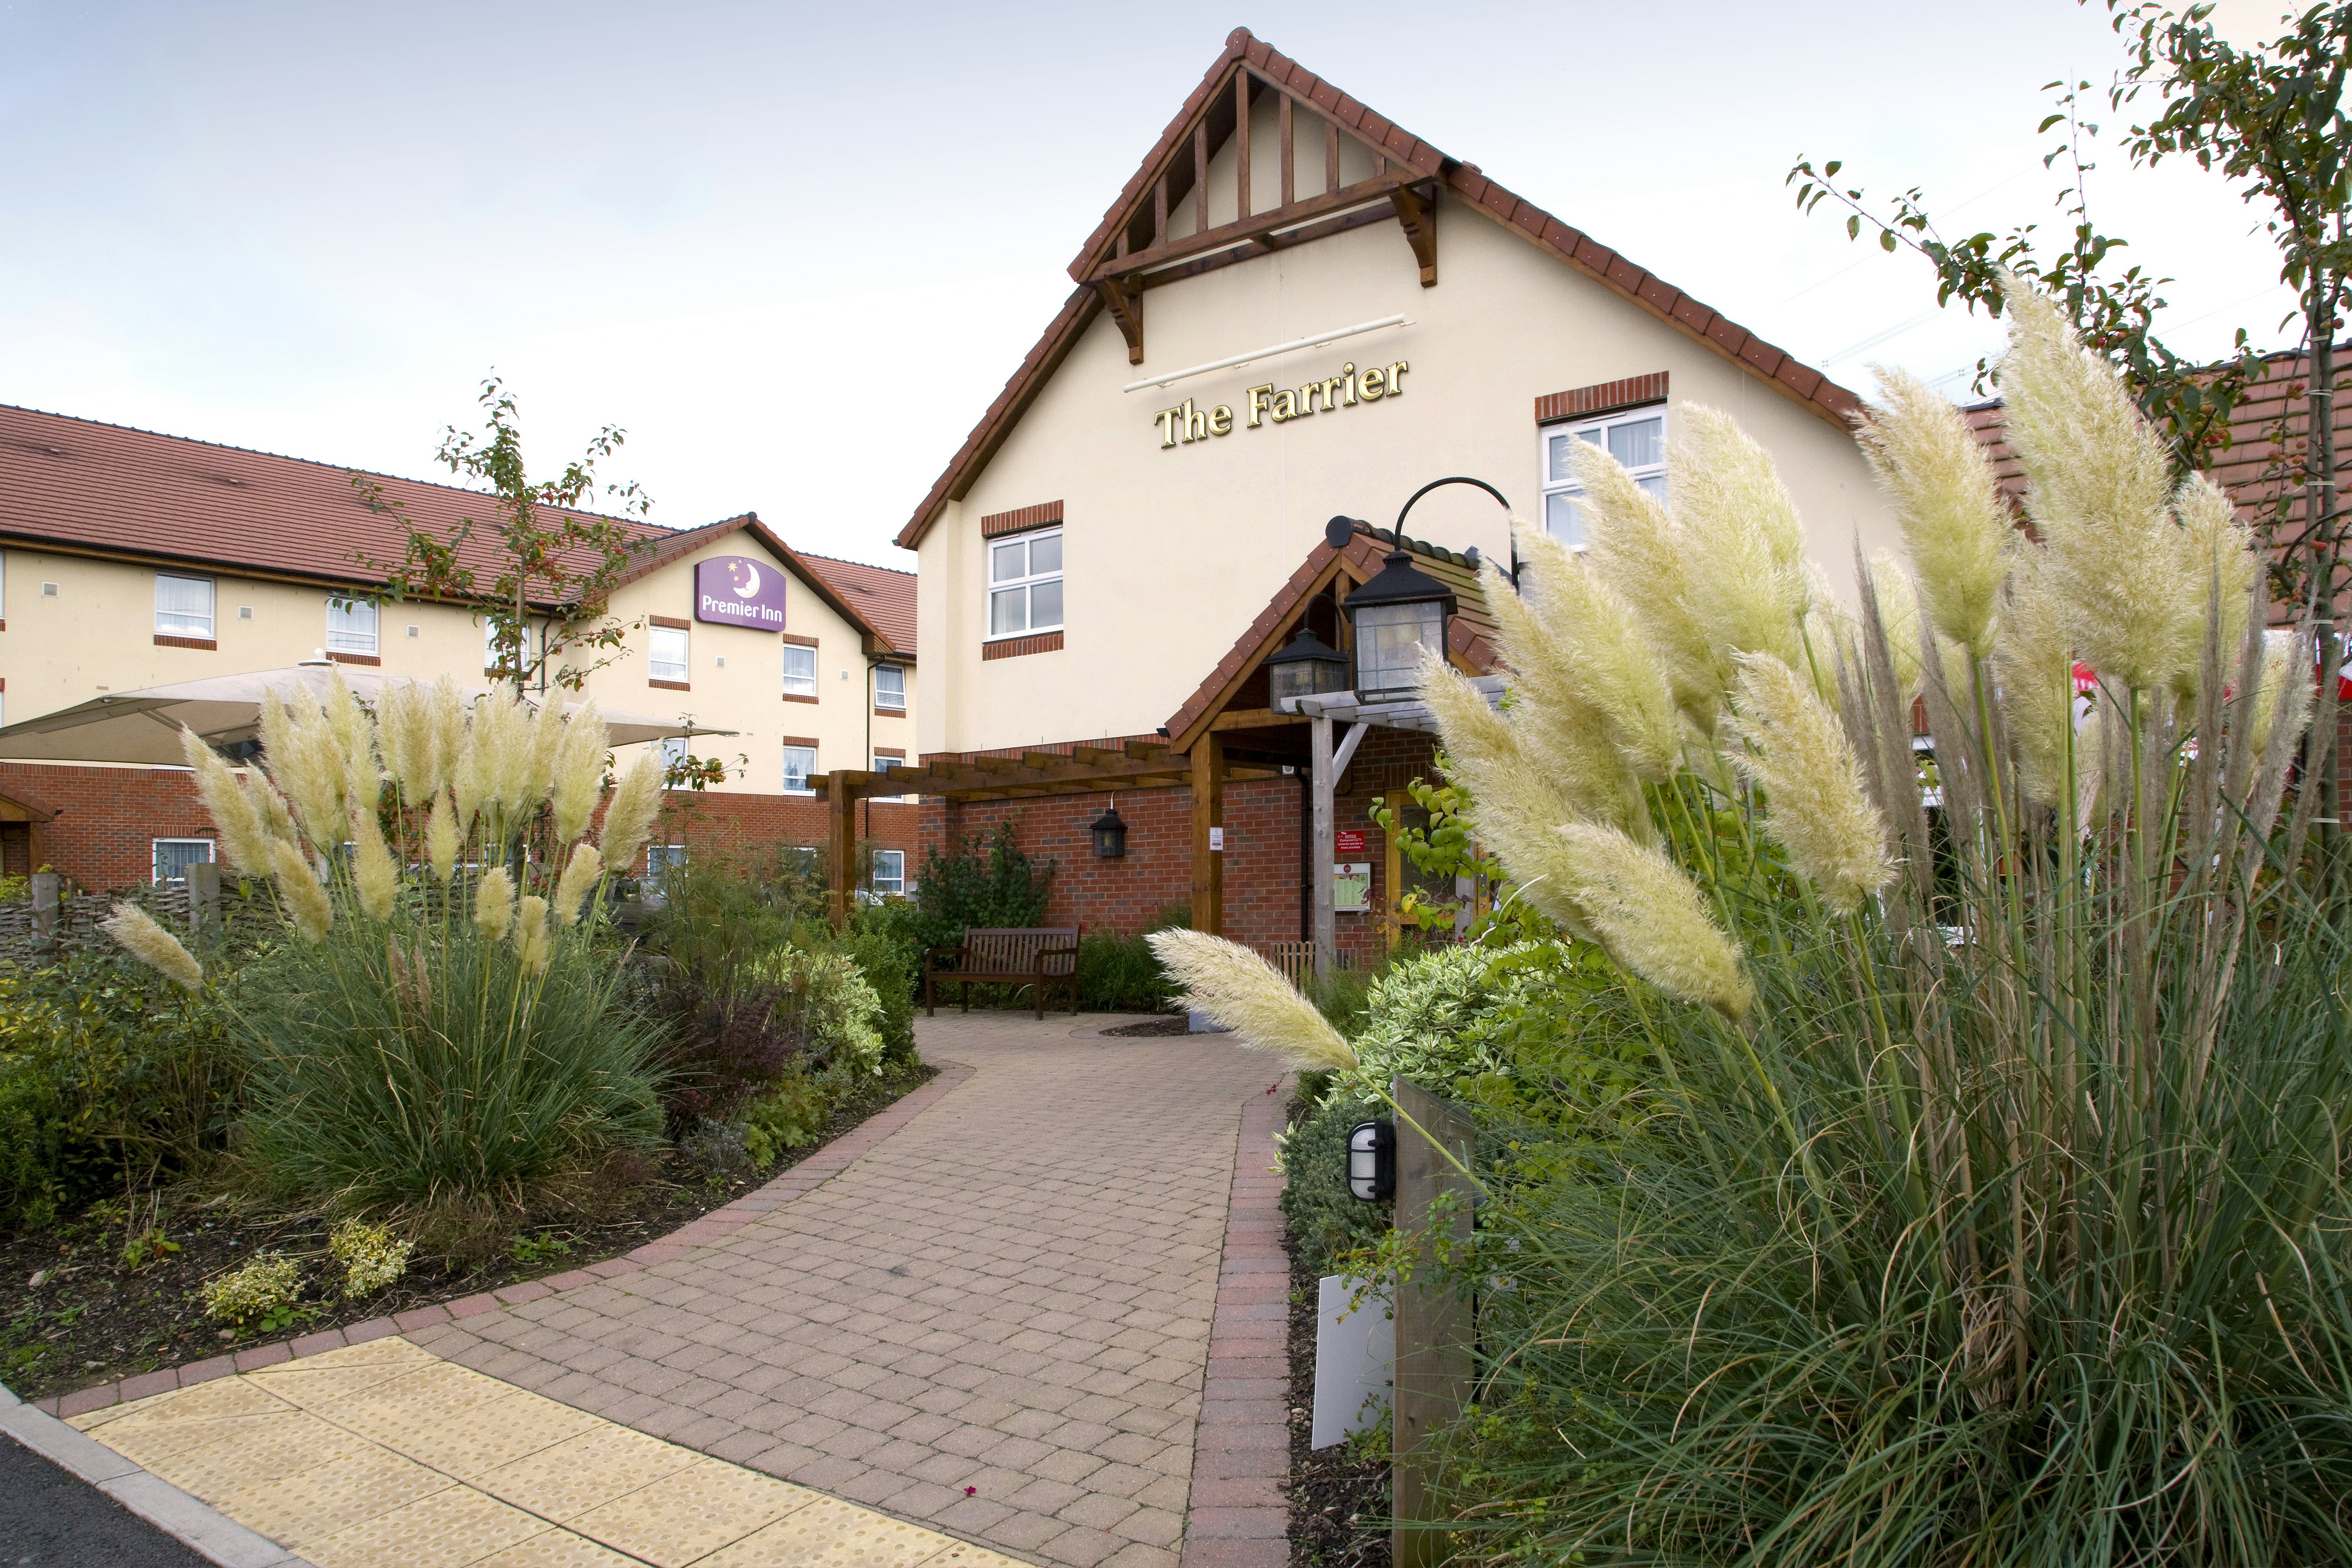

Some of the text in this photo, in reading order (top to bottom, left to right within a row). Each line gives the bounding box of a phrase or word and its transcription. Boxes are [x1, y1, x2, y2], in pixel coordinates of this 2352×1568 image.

[1154, 361, 1408, 449] The Farrier
[702, 595, 783, 622] Premier Inn
